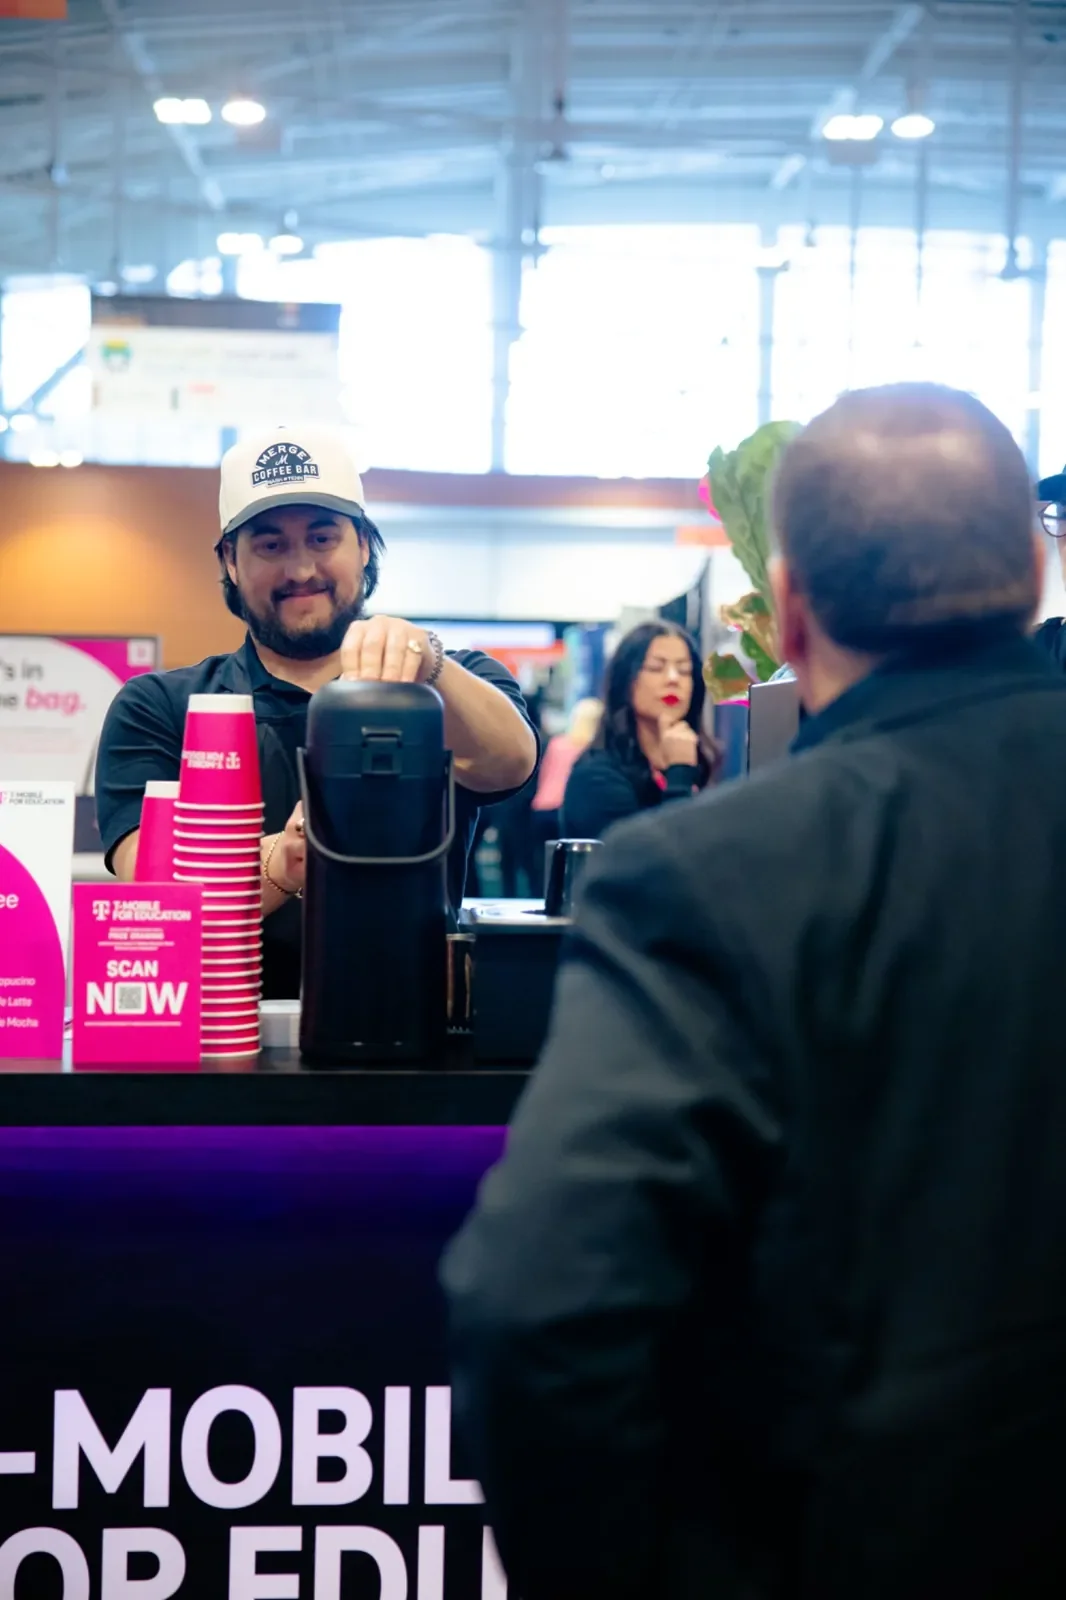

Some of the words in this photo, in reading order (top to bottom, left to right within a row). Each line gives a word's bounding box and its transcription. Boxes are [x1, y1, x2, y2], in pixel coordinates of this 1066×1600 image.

[259, 445, 307, 464] MERGE
[254, 466, 292, 482] COFFEE
[296, 465, 317, 474] BAR
[134, 910, 192, 921] EDUCATION
[106, 960, 158, 978] SCAN
[7, 1016, 39, 1028] Mocha
